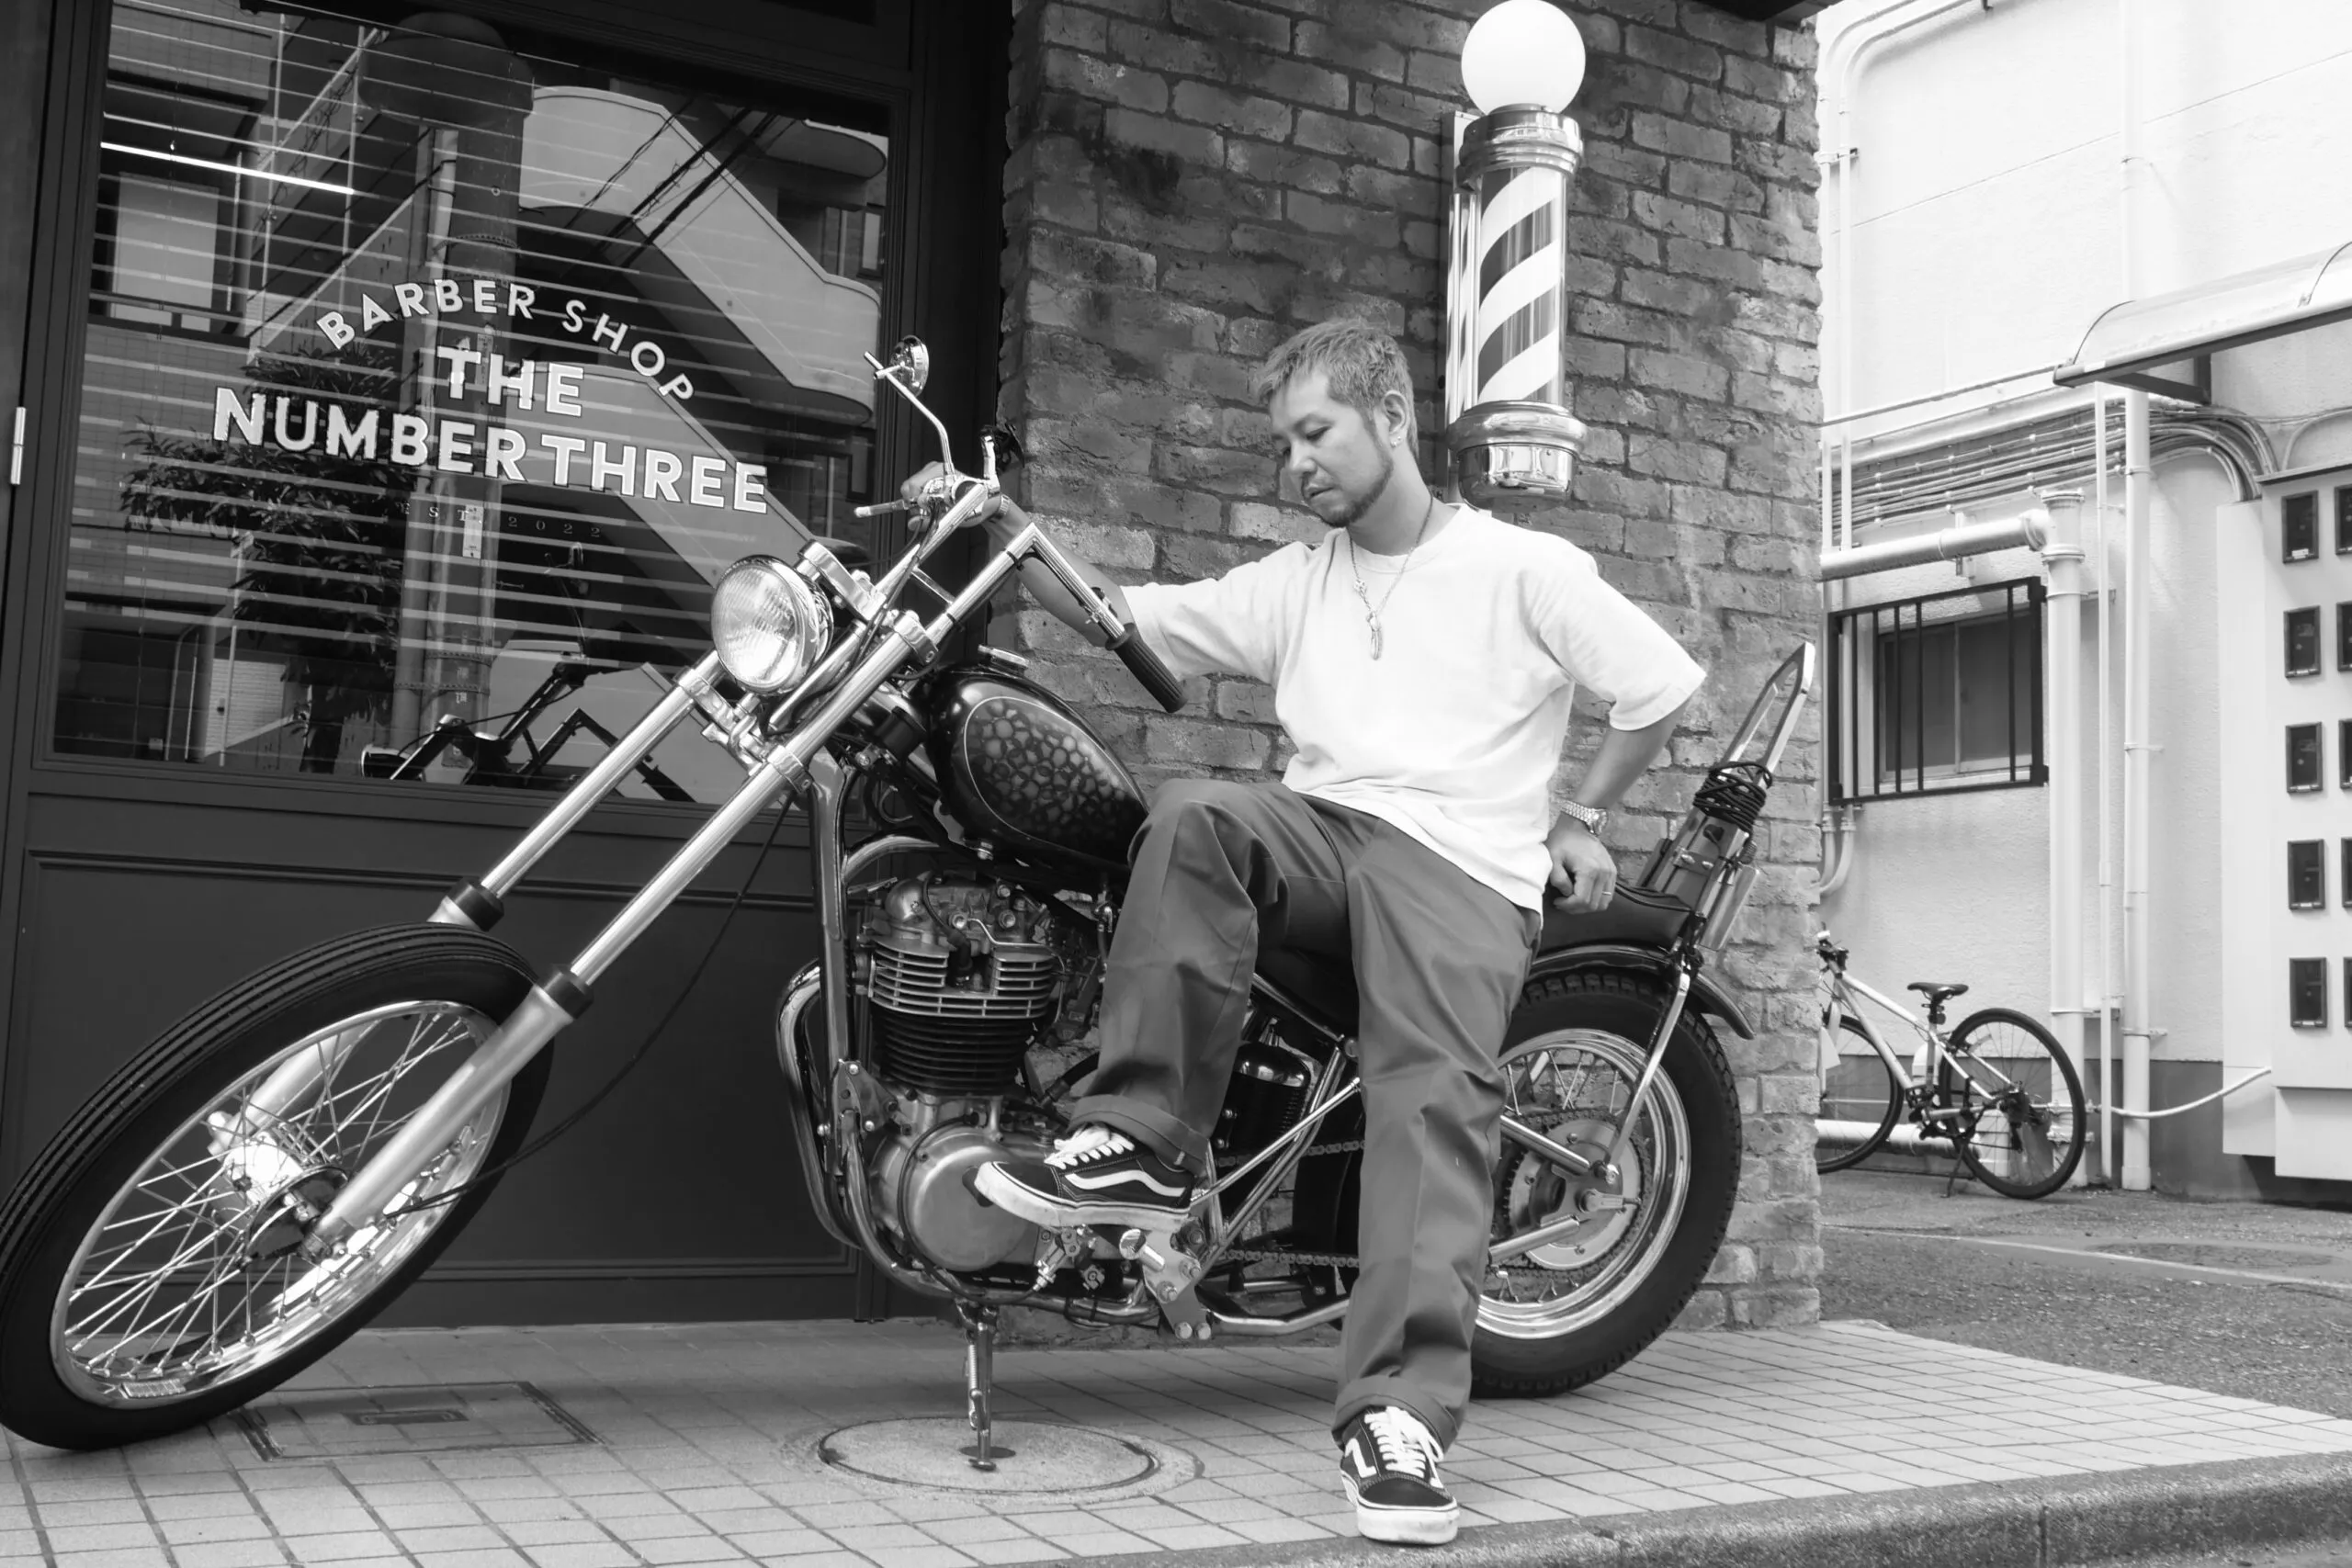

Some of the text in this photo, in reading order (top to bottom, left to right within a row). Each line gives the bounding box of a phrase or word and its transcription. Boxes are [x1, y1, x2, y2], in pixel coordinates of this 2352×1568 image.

[316, 278, 536, 350] BARBER
[561, 299, 694, 400] SHOP
[436, 345, 583, 417] THE
[213, 387, 768, 514] NUMBER THREE
[507, 515, 601, 538] 2022
